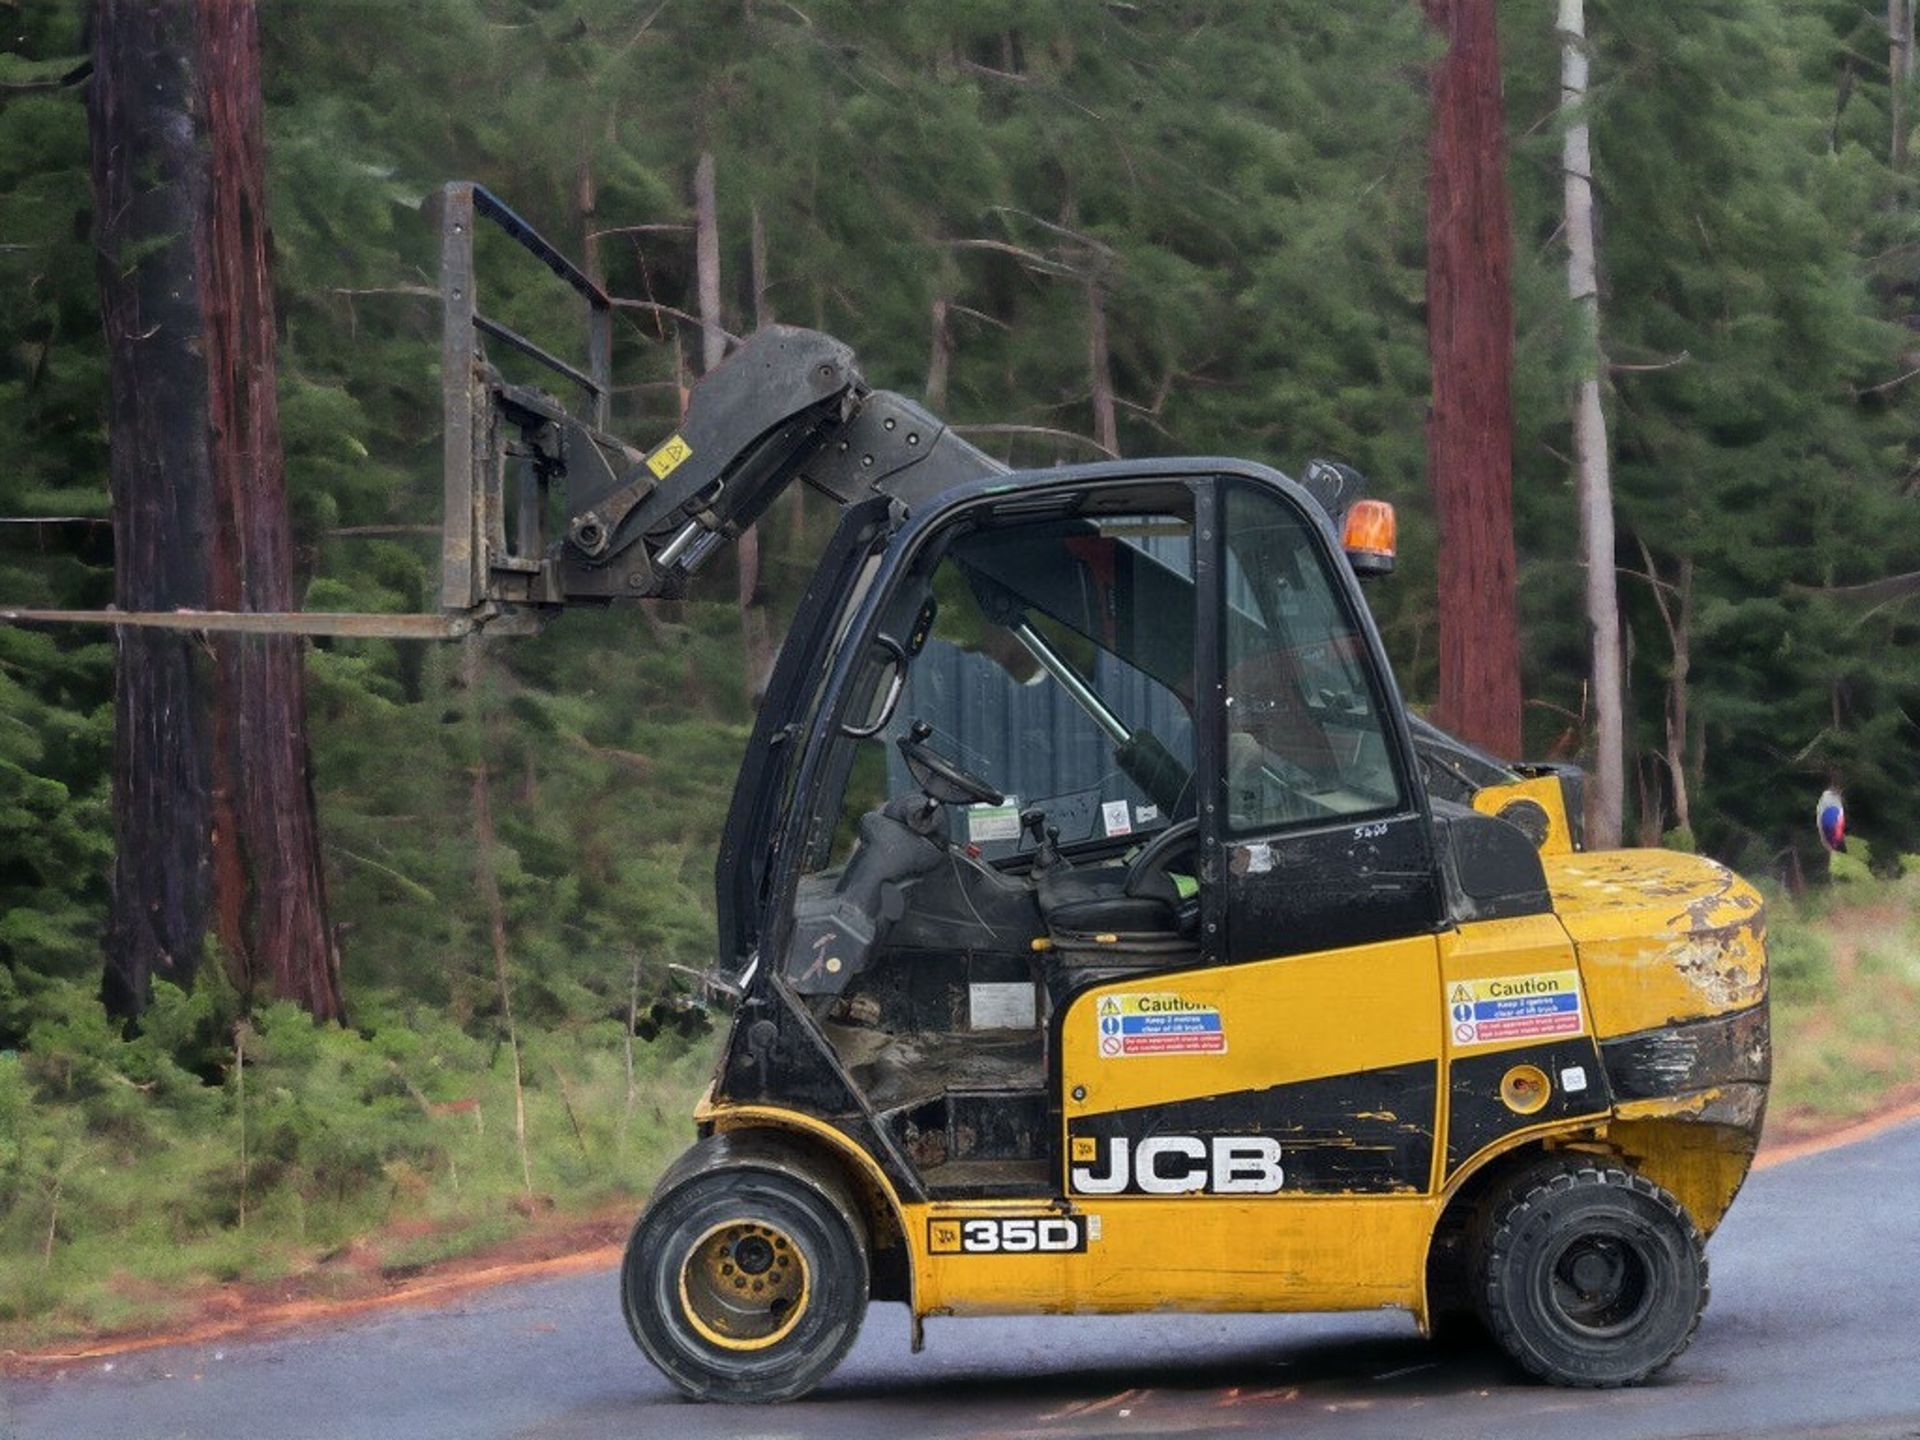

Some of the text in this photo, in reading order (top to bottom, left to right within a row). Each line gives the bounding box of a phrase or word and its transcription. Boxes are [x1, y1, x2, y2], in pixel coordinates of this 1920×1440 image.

[1489, 979, 1559, 997] Caution
[1072, 1137, 1284, 1194] JCB
[964, 1219, 1078, 1252] 35D
